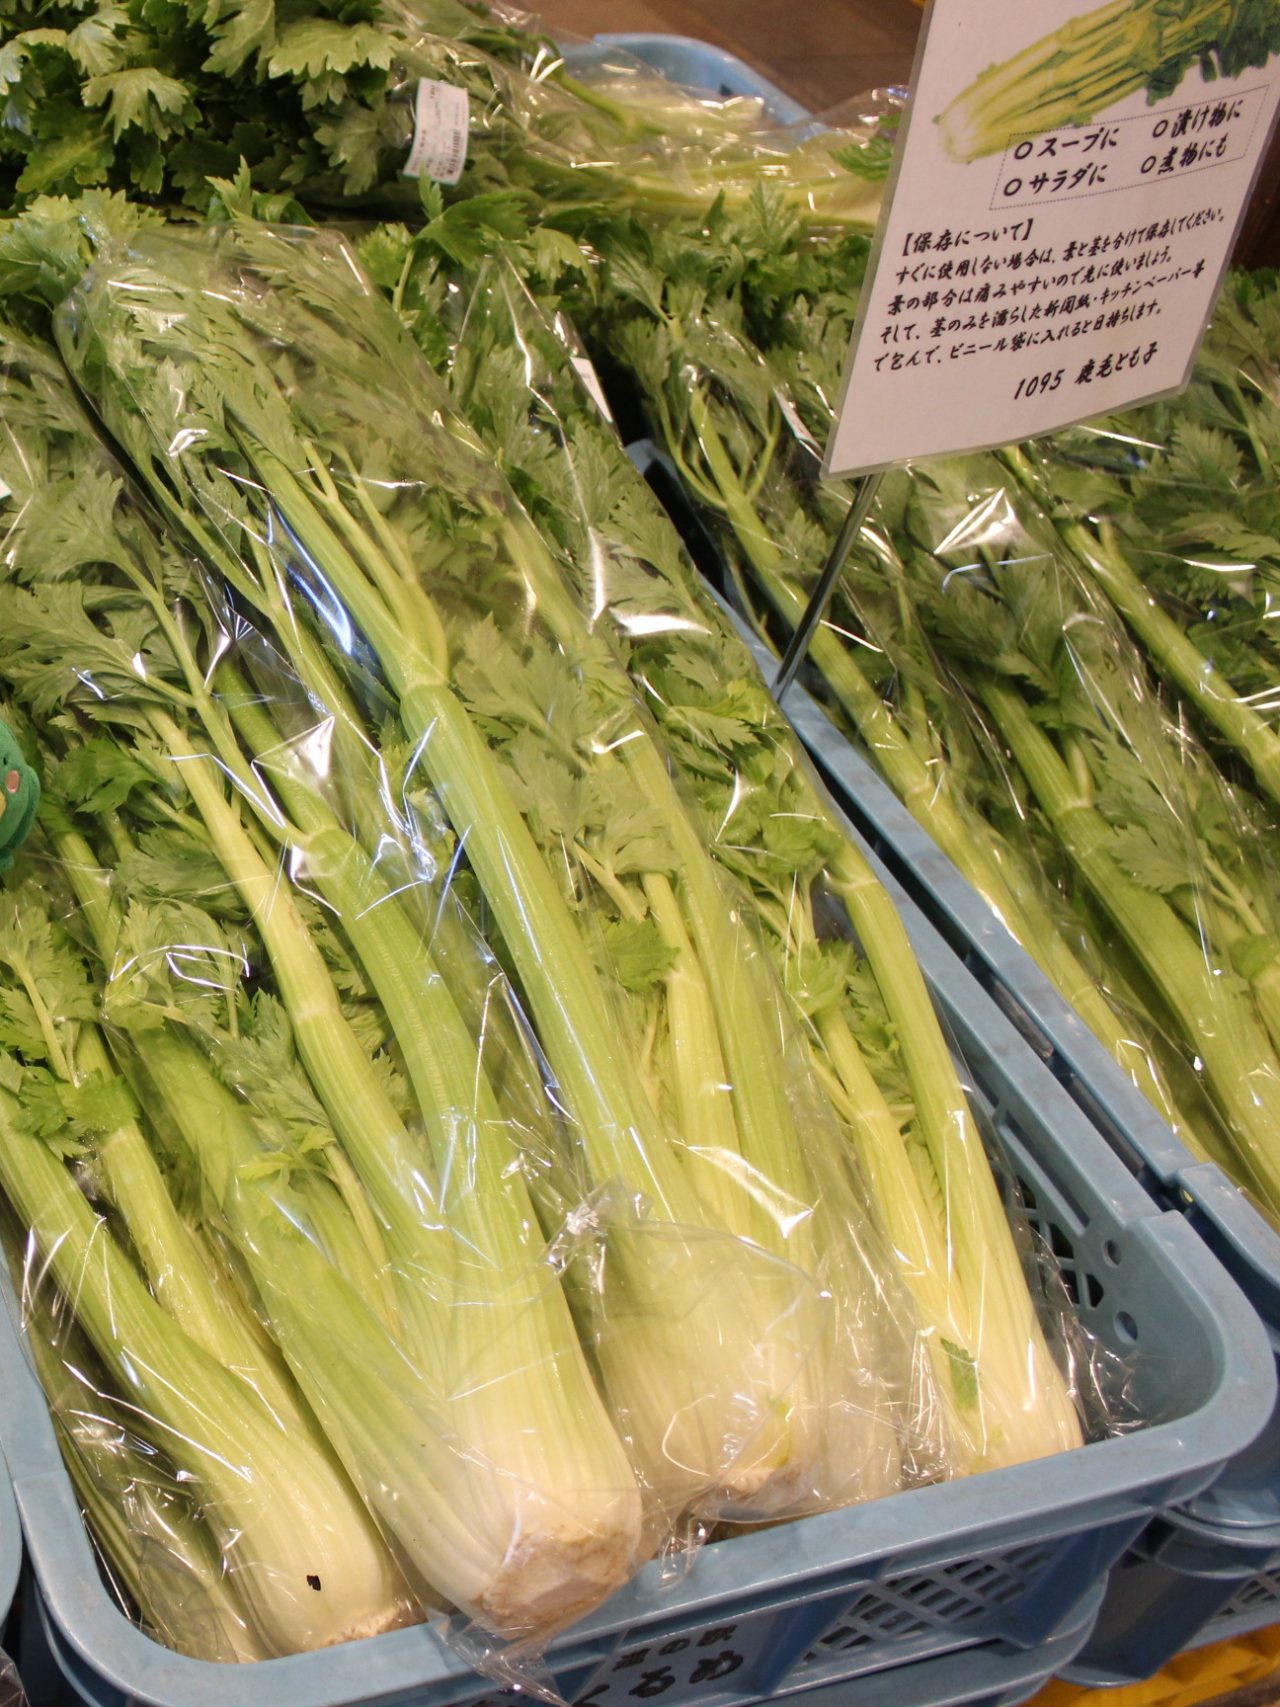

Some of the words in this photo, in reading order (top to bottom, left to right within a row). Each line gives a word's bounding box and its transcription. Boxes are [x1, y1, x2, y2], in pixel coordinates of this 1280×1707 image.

[902, 218, 1034, 256] 【保存について】
[1014, 368, 1065, 400] 1095
